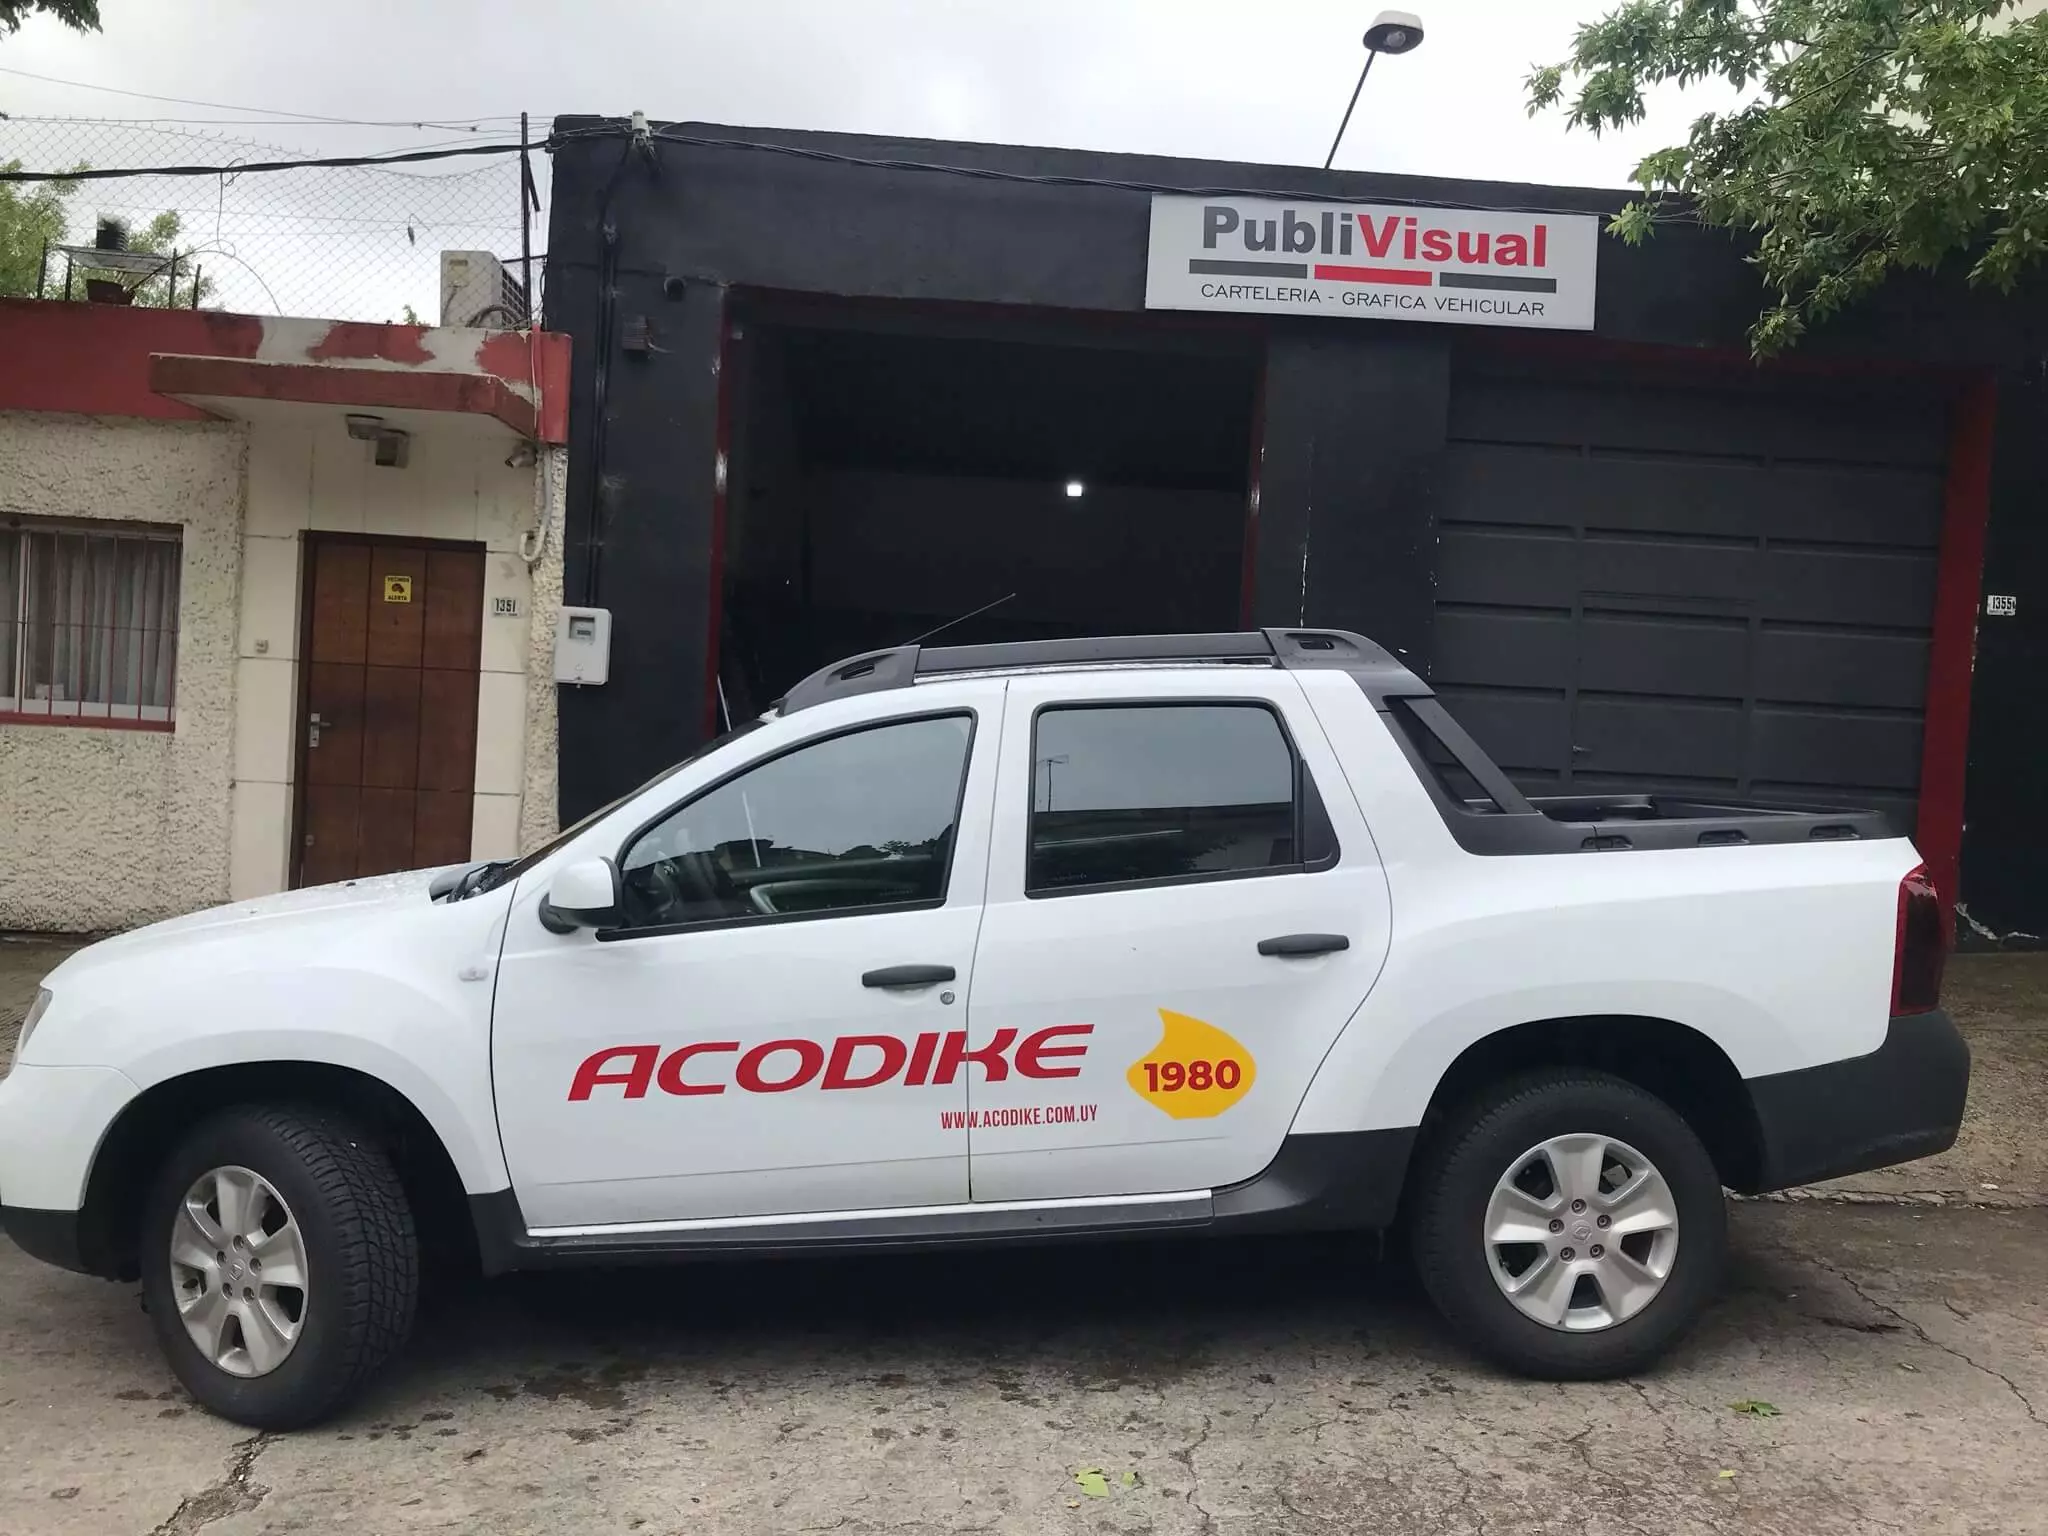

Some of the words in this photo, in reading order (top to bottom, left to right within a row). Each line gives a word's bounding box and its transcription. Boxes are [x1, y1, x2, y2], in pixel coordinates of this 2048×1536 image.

[1203, 205, 1548, 268] PubliVisual
[1201, 283, 1321, 303] CARTELERIA
[1342, 291, 1427, 310] GRAFICA
[1434, 297, 1545, 316] VEHICULAR
[495, 598, 516, 612] 1351
[1992, 596, 2012, 610] 1355
[568, 1024, 1094, 1101] ACODIKE
[1144, 1060, 1241, 1092] 1980
[941, 1104, 1098, 1129] WWW.ACODIKE.COM.UY
